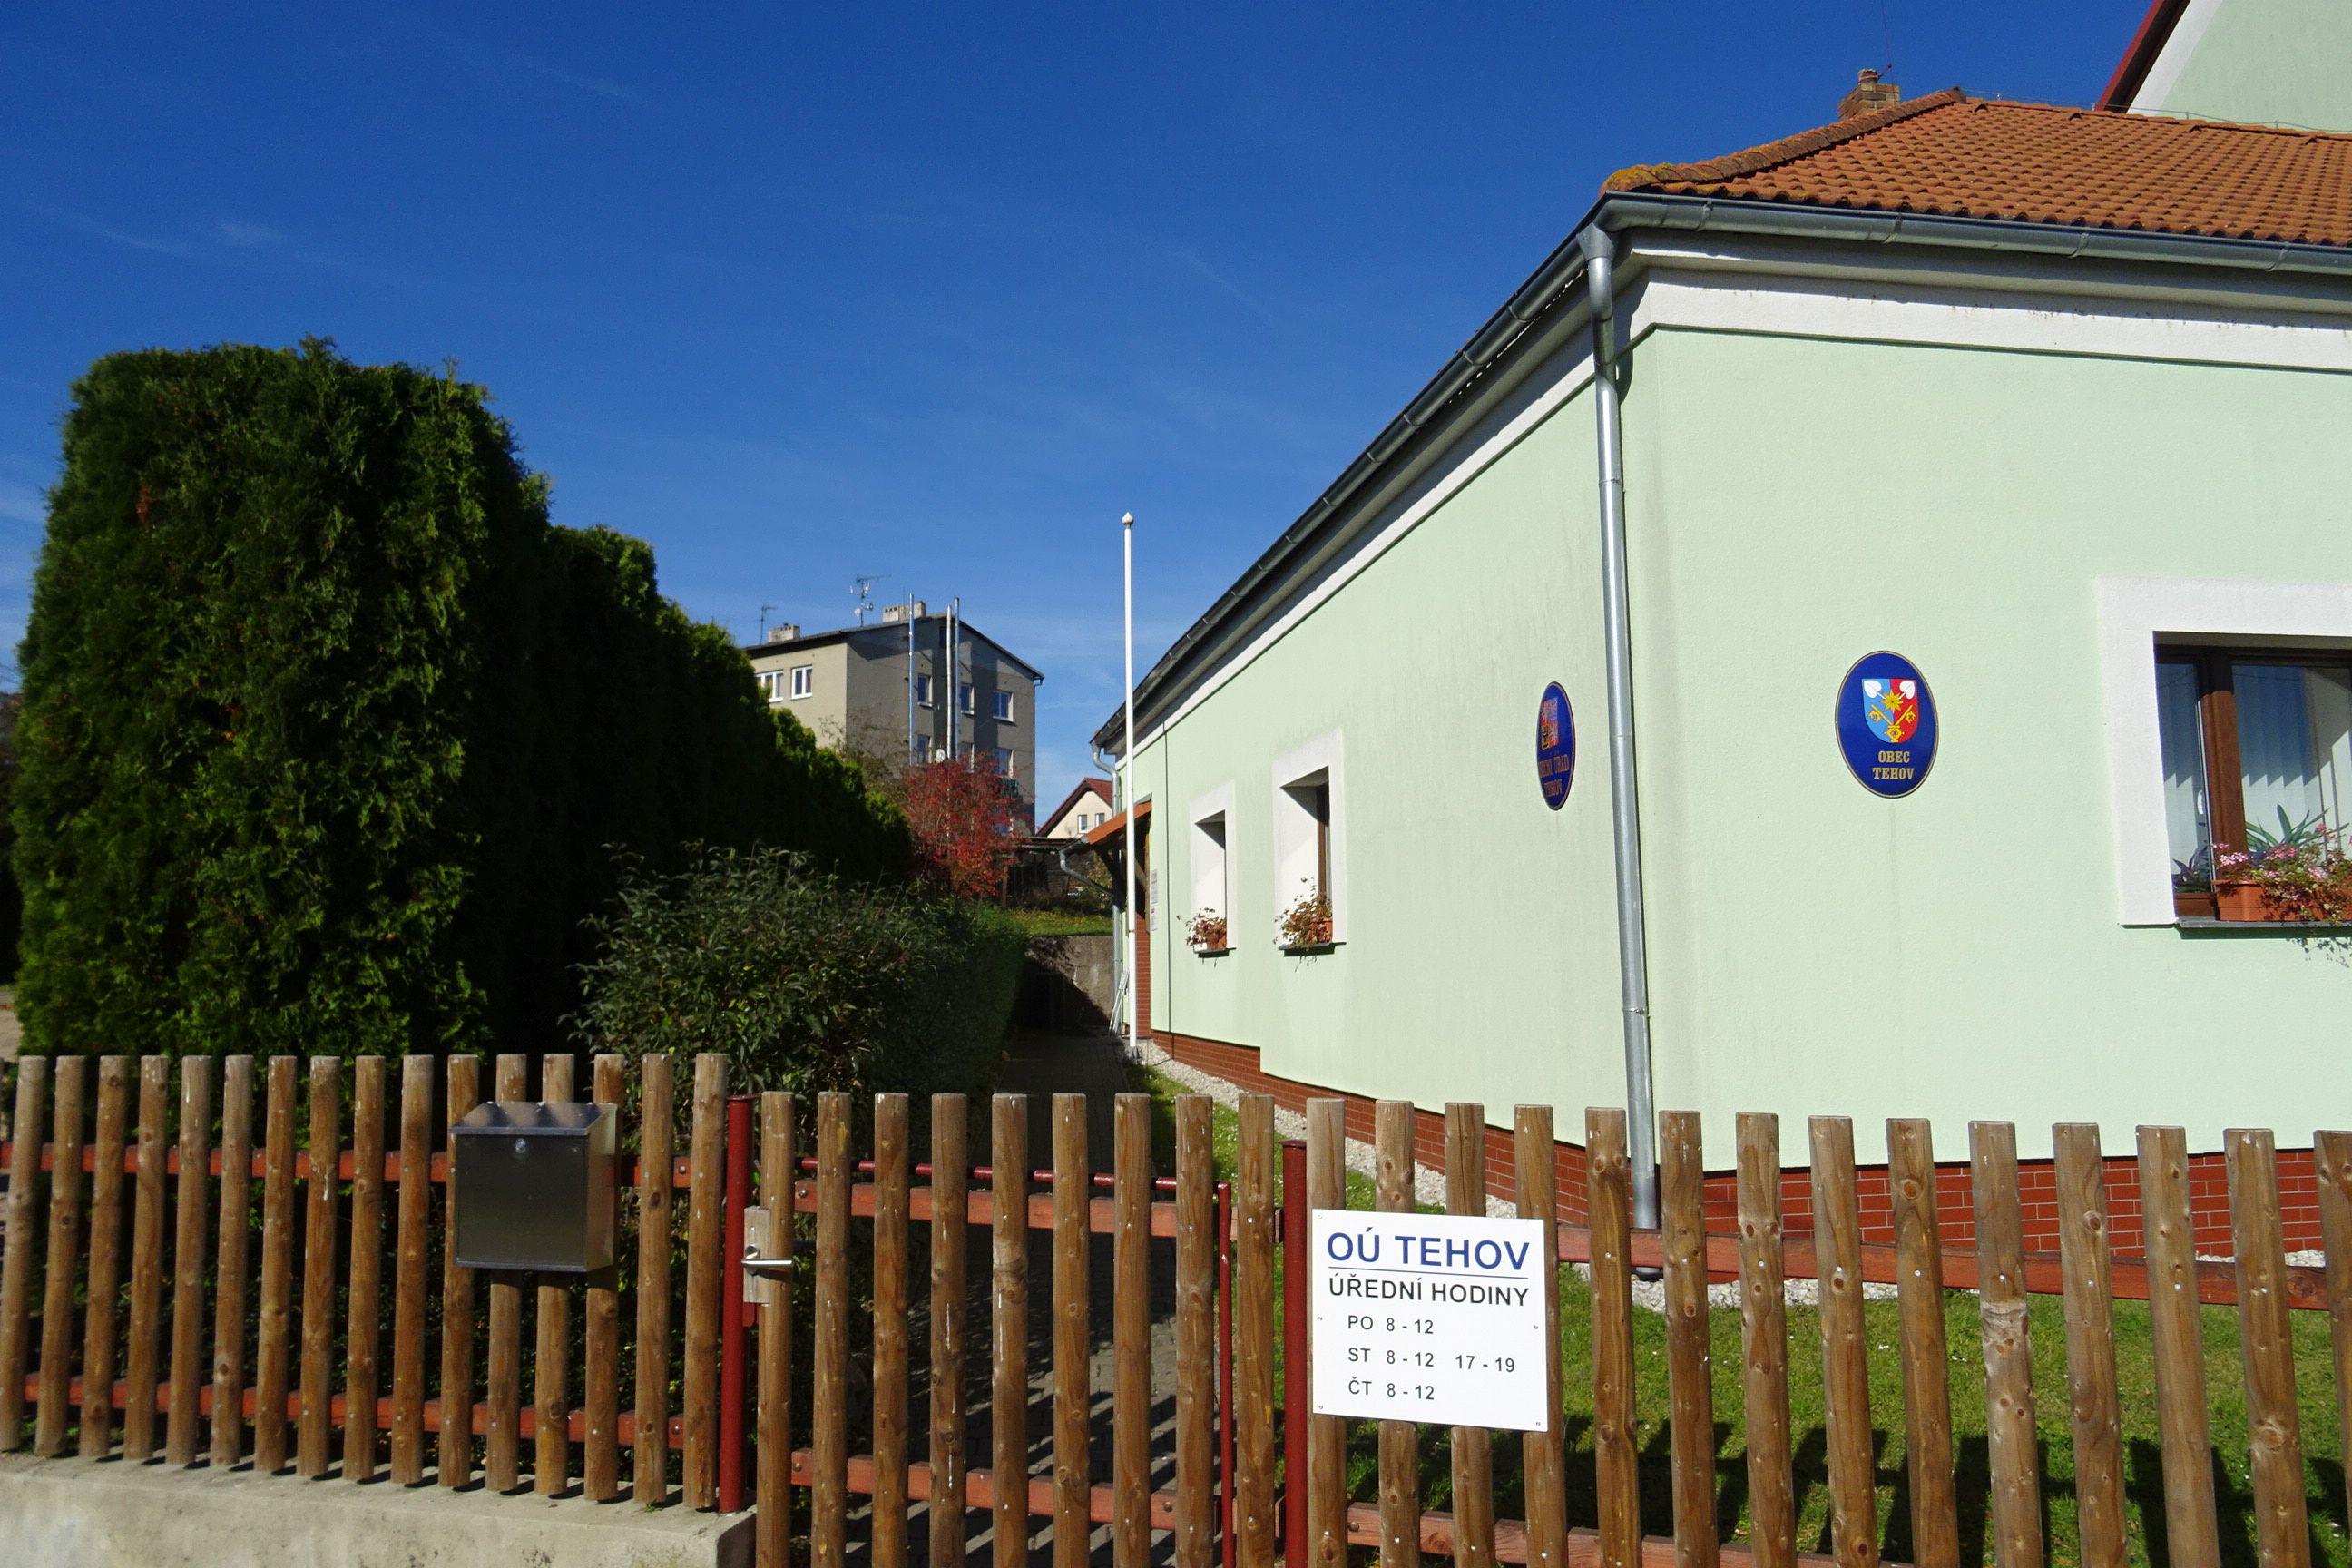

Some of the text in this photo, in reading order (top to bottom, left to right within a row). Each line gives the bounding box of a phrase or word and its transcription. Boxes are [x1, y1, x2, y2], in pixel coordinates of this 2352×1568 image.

[1877, 750, 1910, 763] OBEC
[1872, 767, 1915, 779] TEHOV
[1327, 1226, 1530, 1270] OÚ TEHOV
[1328, 1272, 1530, 1307] ÚŘEDNÍ HODINY
[1348, 1314, 1374, 1330] PO
[1348, 1347, 1371, 1363] ST
[1348, 1376, 1373, 1396] ČT
